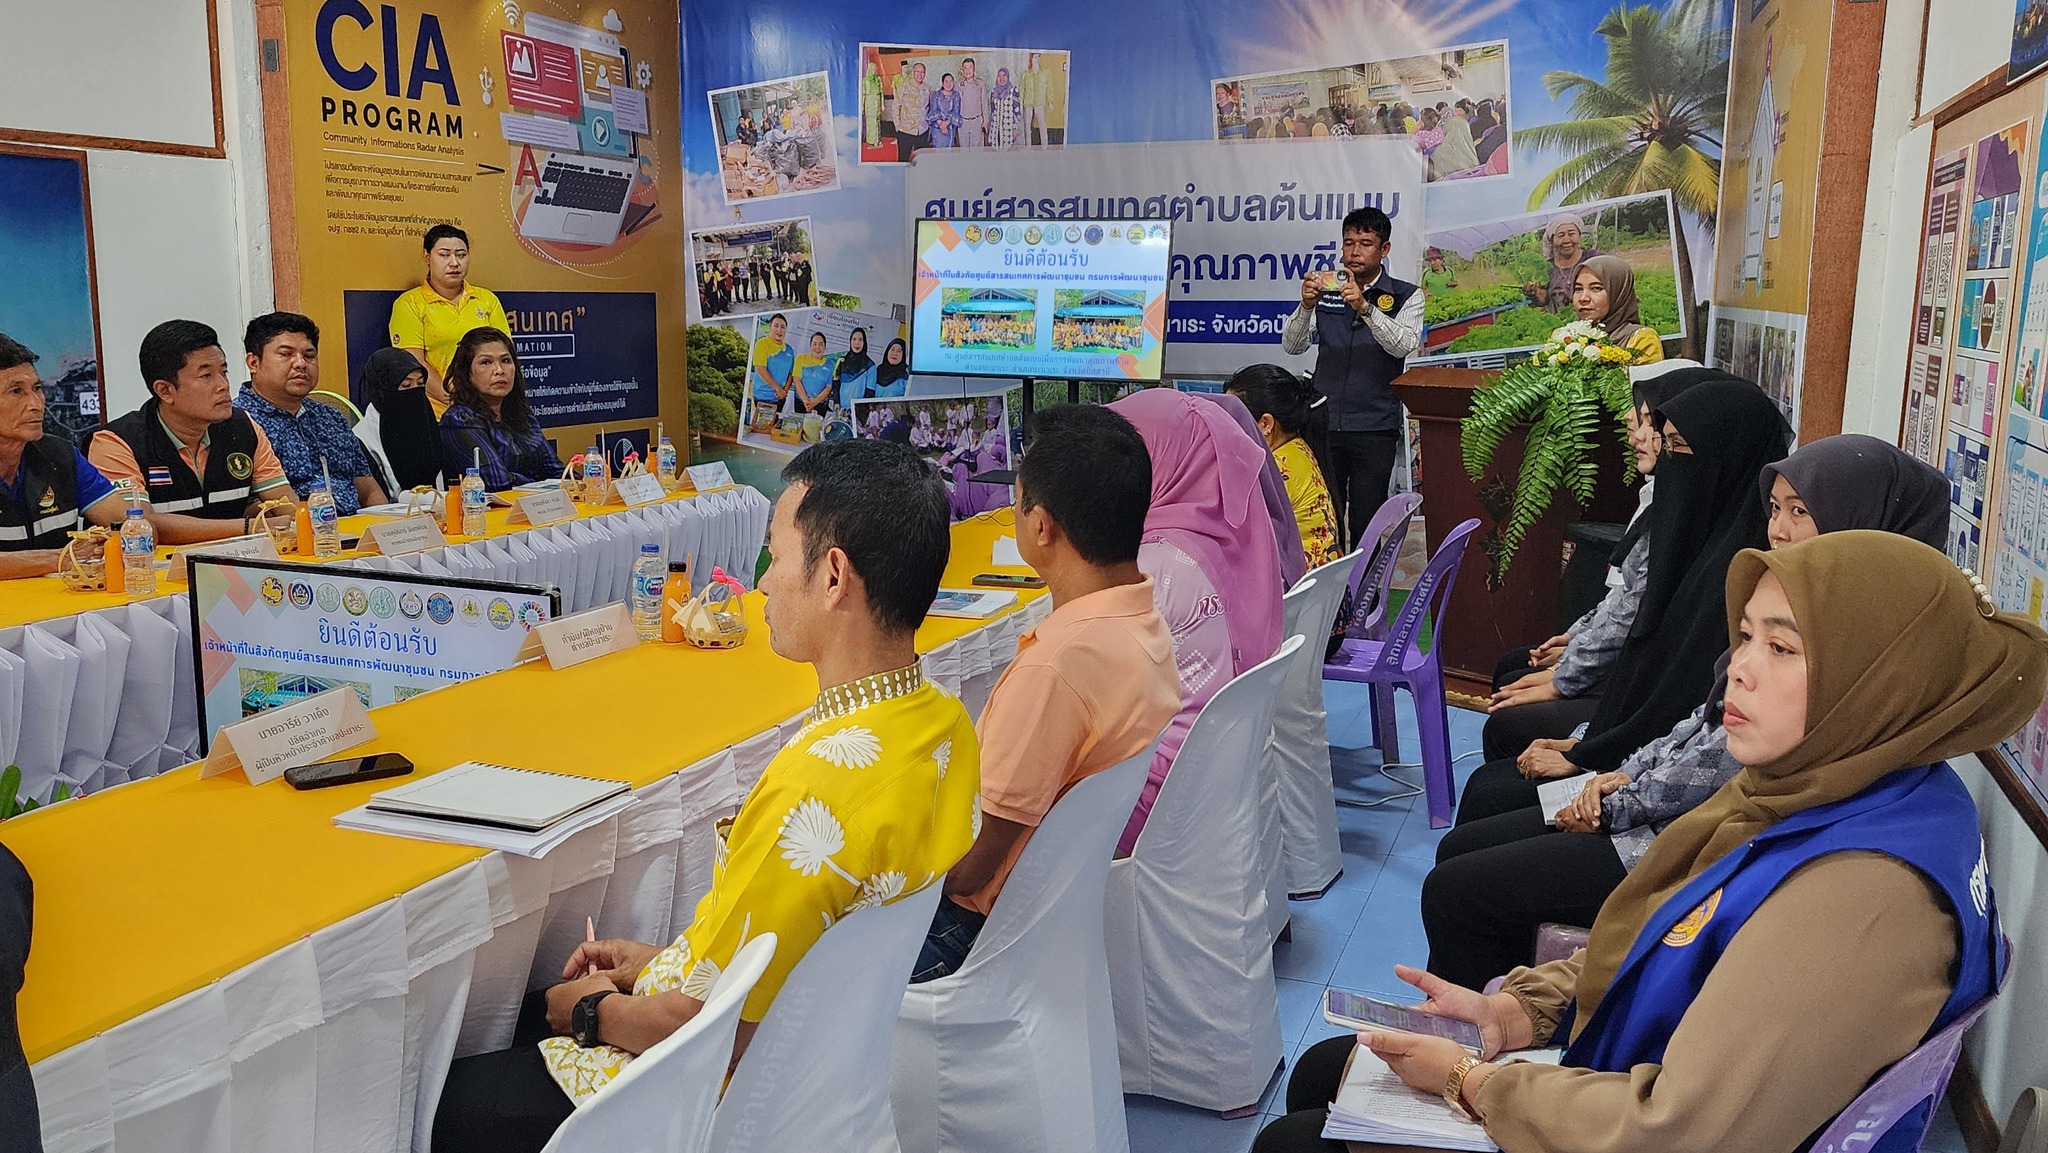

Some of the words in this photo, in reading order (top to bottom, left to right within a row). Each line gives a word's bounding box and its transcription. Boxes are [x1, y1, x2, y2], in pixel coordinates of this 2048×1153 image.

[316, 0, 462, 107] CIA
[321, 96, 463, 139] PROGRAM
[323, 131, 367, 147] Community
[371, 136, 415, 151] Informations
[417, 141, 436, 153] Radar
[437, 143, 465, 157] Analysis
[1003, 248, 1089, 267] ยินดีต้อนรับ
[1211, 313, 1290, 334] จังหวัดปั
[1386, 571, 1437, 666] ลูกหลานอุทิศให้
[318, 617, 438, 657] ยินดีต้อนรับ
[561, 622, 613, 645] กำนัน/ผู้ใหญ่บ้าน
[571, 634, 612, 652] ตำบลปะนาเระ
[204, 638, 434, 678] เจ้าหน้าที่ในสังกัดศูนย์สารสนเทศการพัฒนาชุมชน
[258, 715, 302, 740] นายอารีย์
[288, 726, 327, 747] ปลัดอำเภอ
[255, 722, 366, 773] ผู้เป็นหัวหน้าประจำตำบลปะนาเระ
